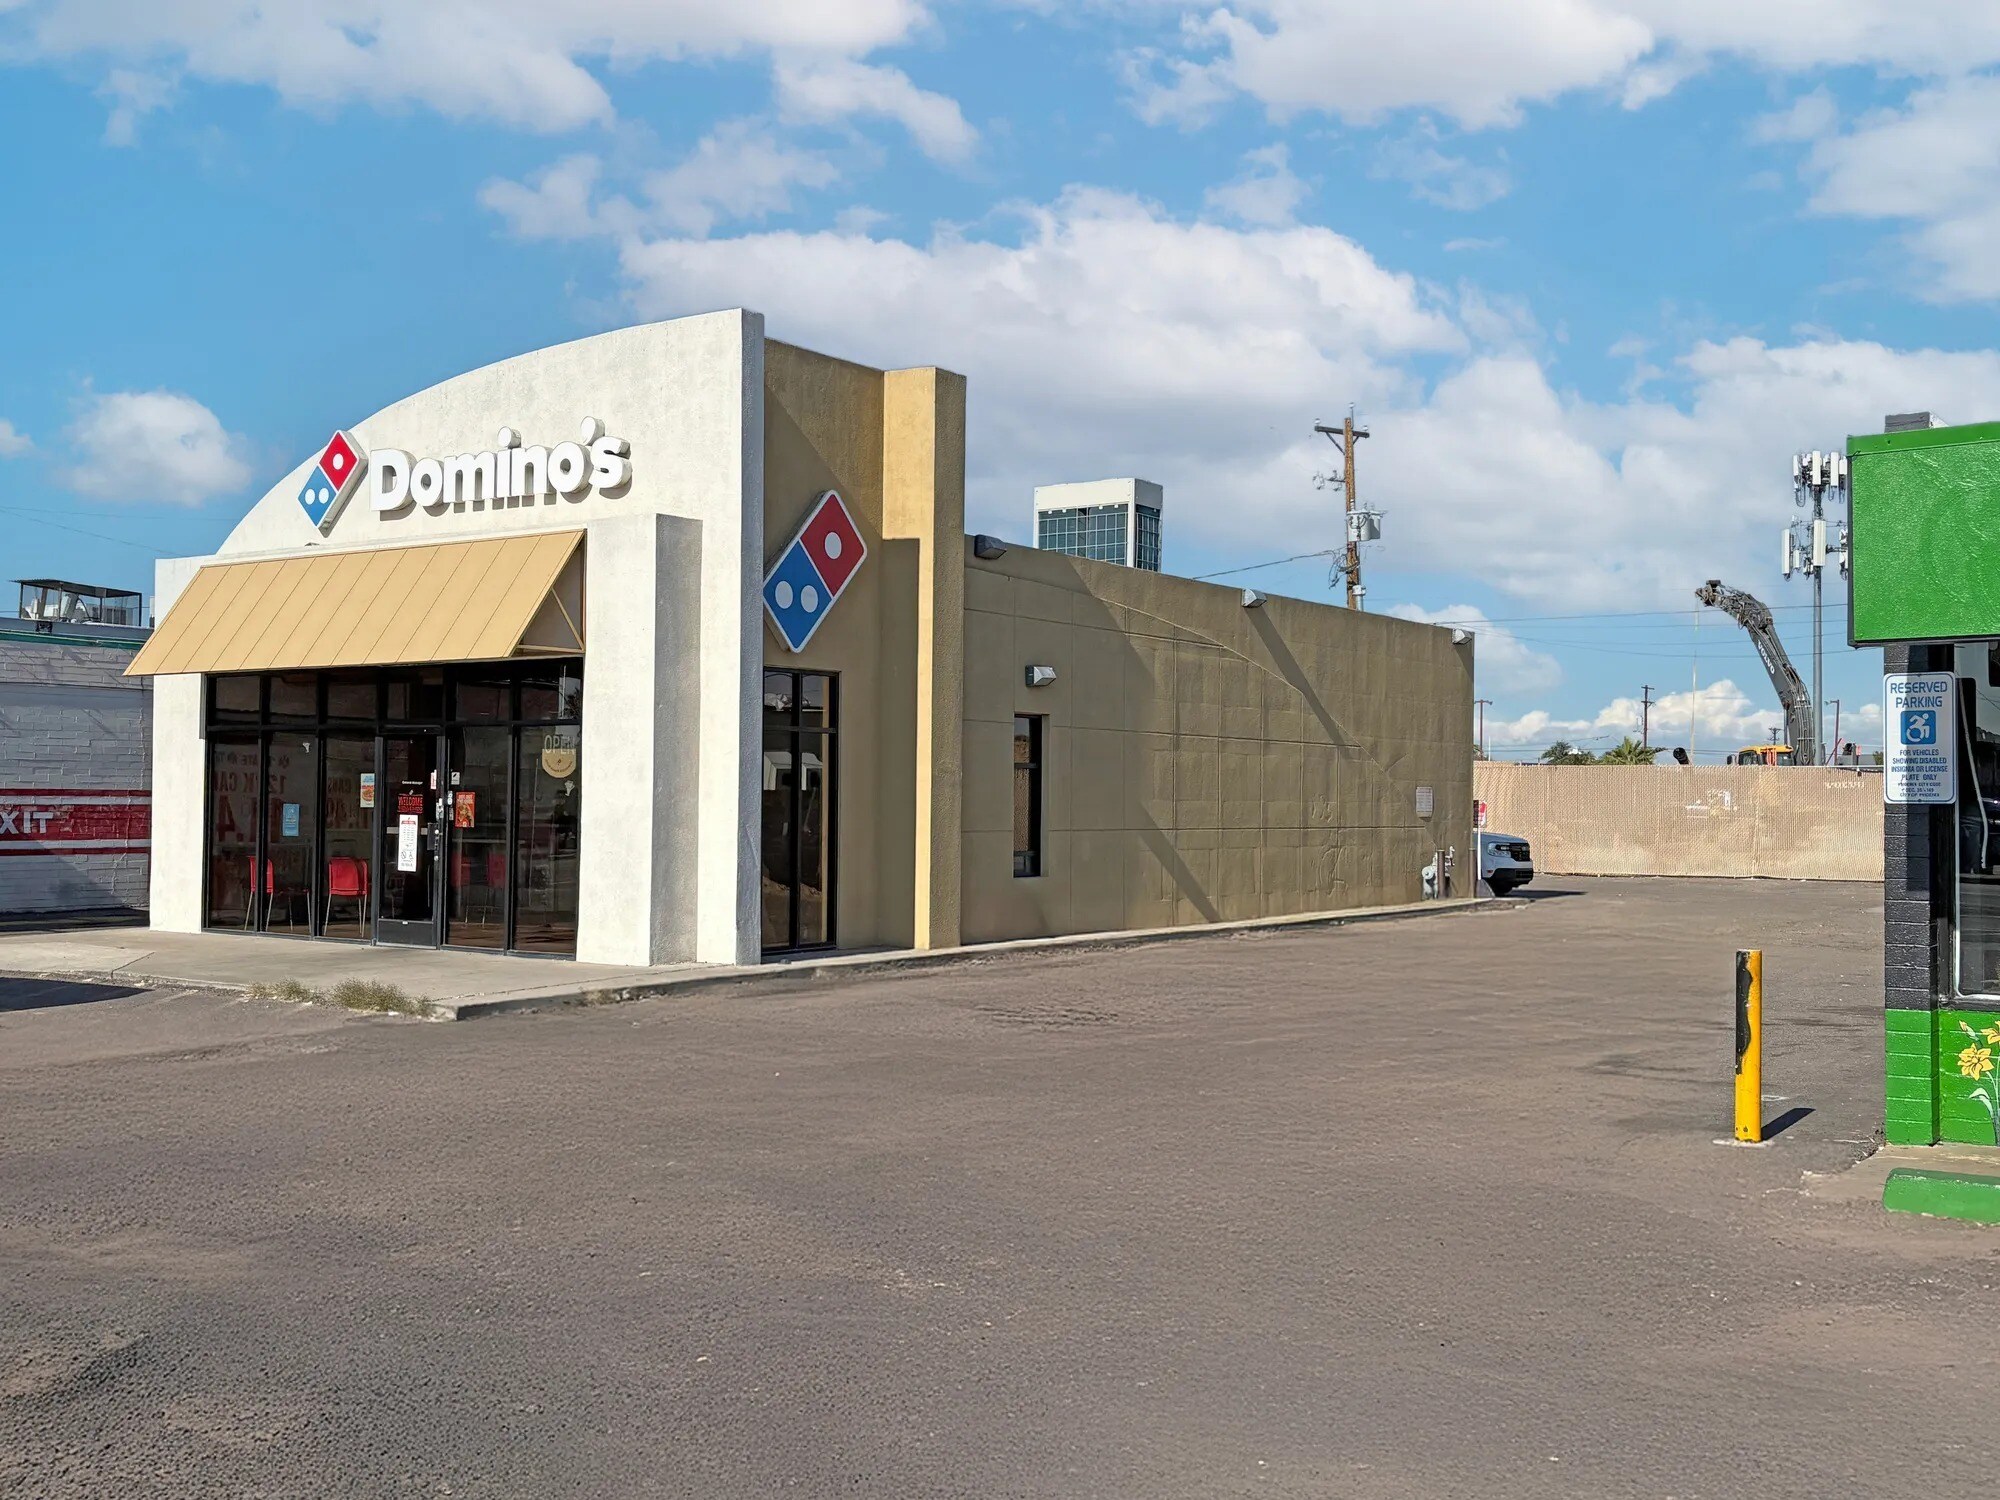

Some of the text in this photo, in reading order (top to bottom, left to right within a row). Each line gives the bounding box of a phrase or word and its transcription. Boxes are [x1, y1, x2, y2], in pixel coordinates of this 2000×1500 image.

[370, 416, 632, 511] Domino's
[1757, 639, 1775, 675] VOLVO
[1890, 681, 1948, 694] RESERVED
[1895, 696, 1943, 708] PARKING
[544, 735, 575, 755] OPEN
[1912, 748, 1939, 756] VEHICLES
